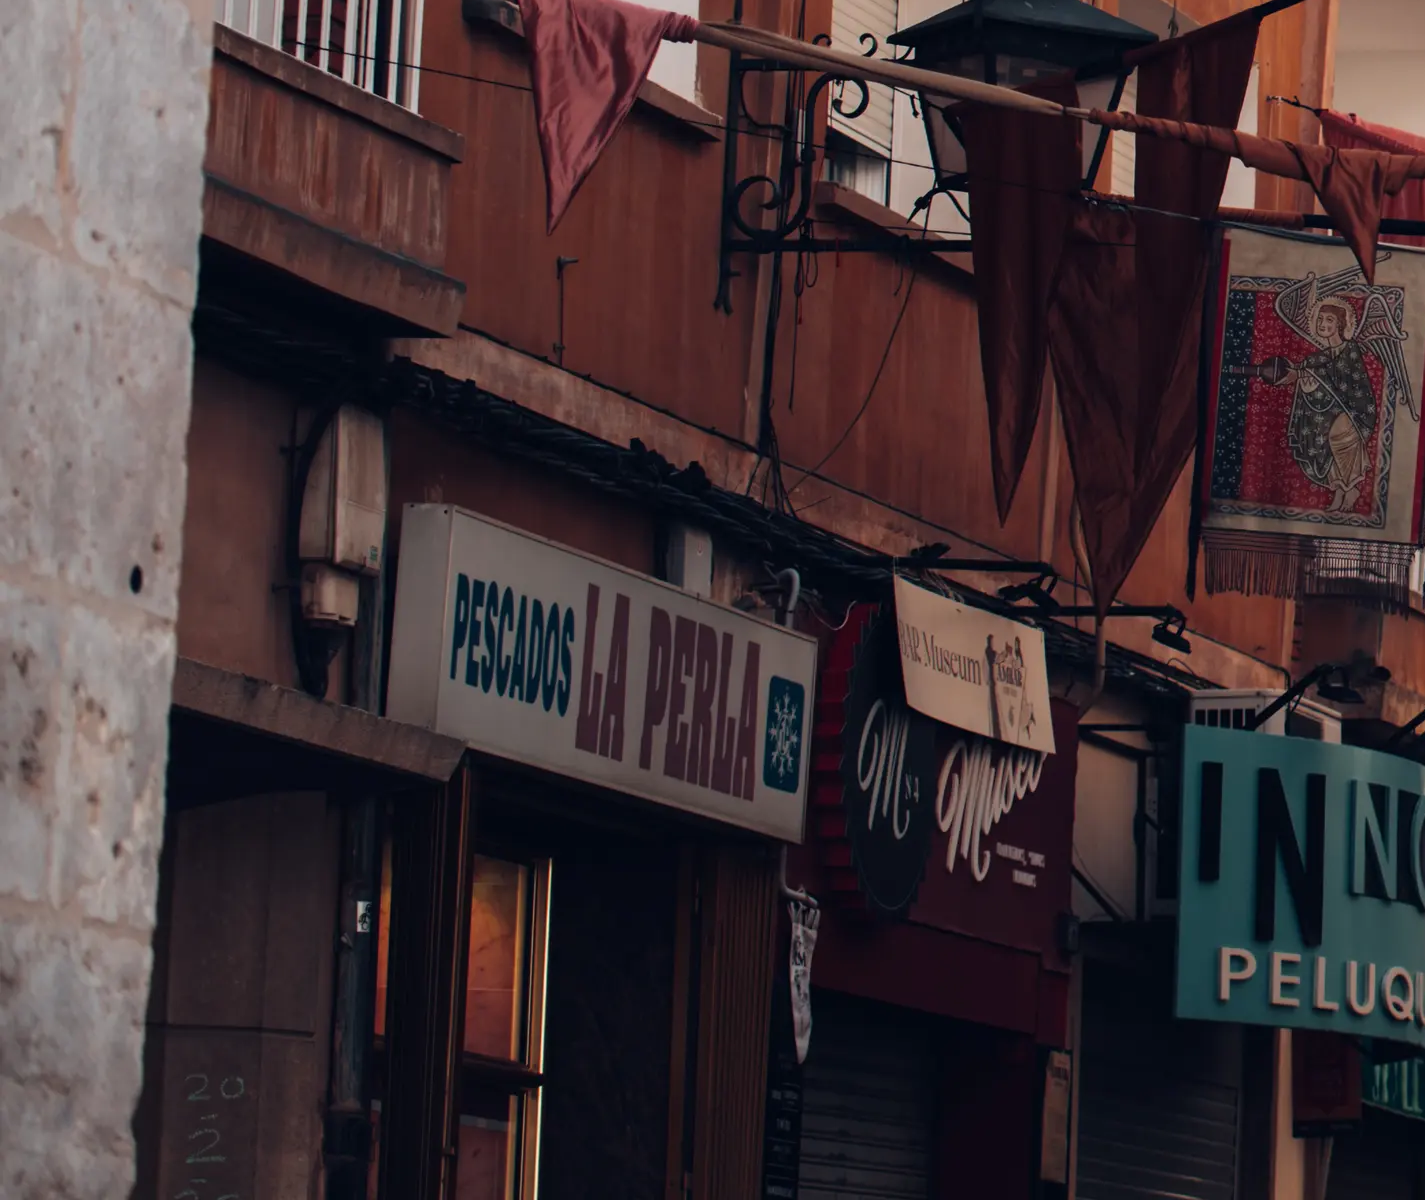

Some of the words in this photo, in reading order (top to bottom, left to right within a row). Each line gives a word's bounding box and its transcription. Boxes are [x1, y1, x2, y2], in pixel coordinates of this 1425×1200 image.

[450, 572, 575, 718] PESCADOS
[574, 583, 630, 762] LA
[638, 607, 762, 802] PERLA
[922, 631, 982, 686] Museum
